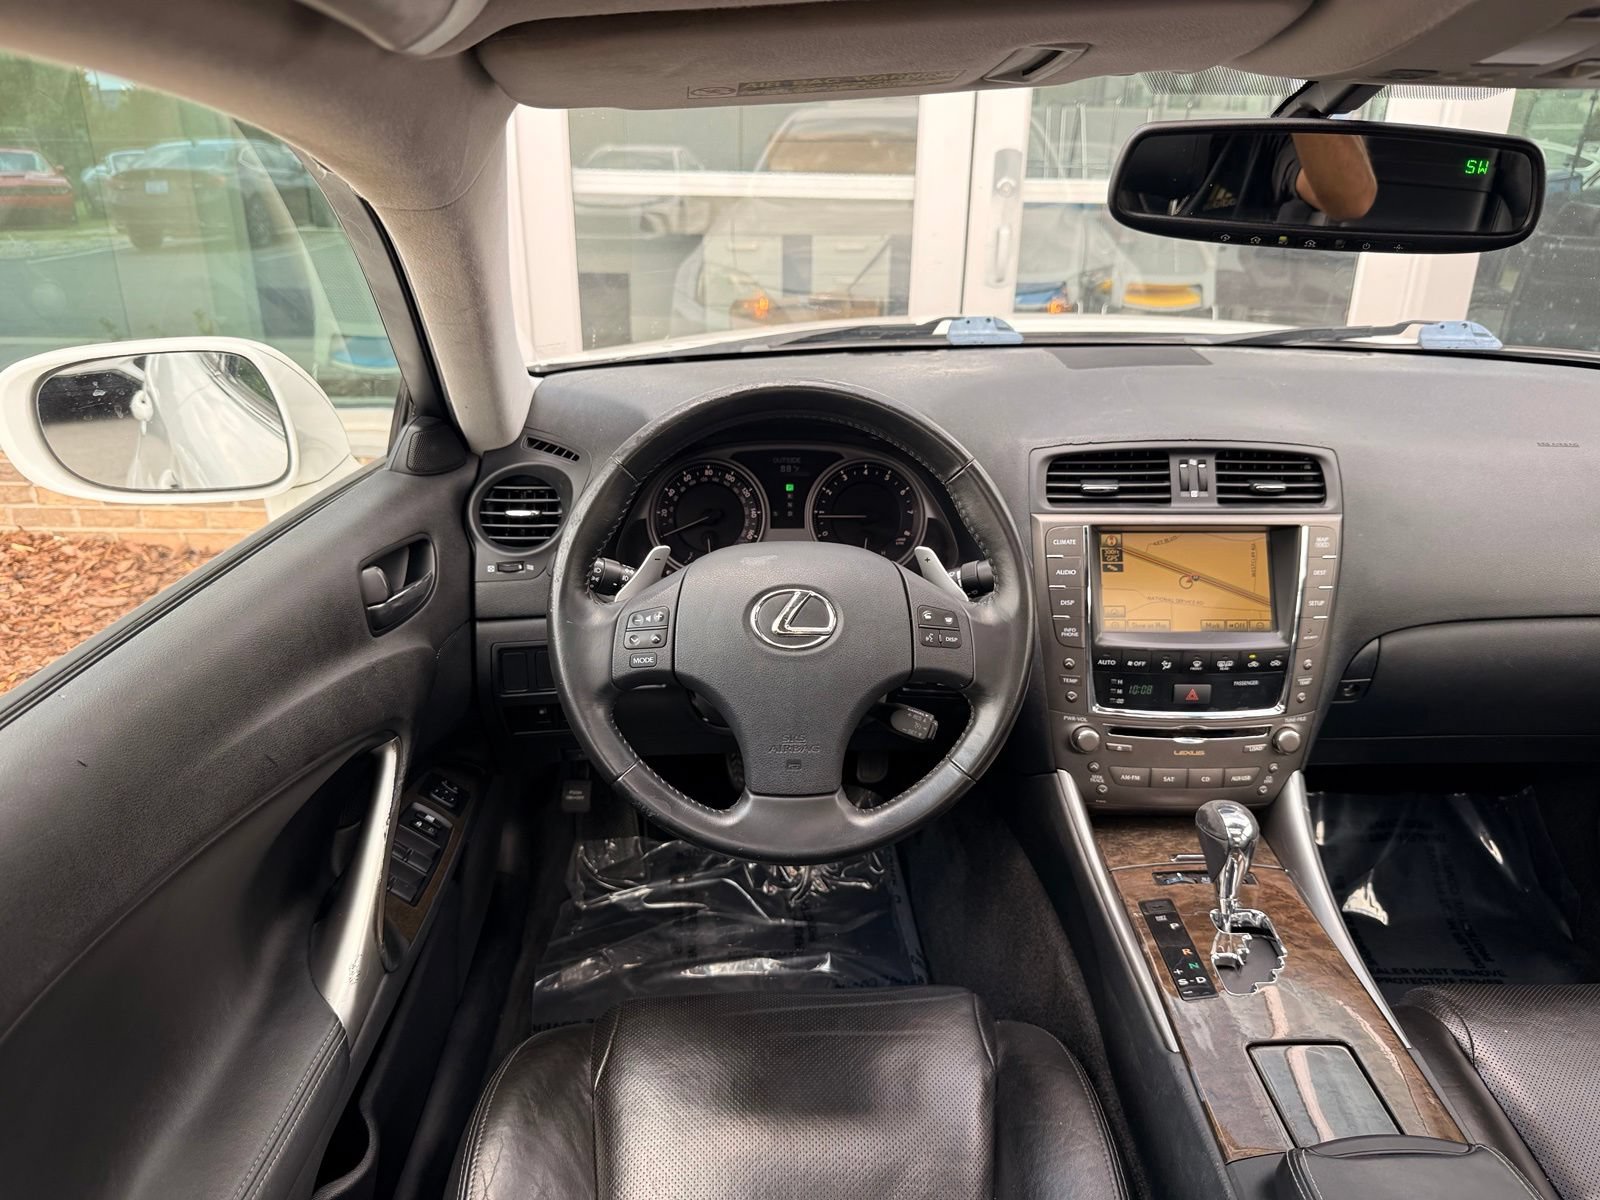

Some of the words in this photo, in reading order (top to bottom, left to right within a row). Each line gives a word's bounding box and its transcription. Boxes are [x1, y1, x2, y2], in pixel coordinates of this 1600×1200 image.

[1465, 159, 1489, 174] SW
[1128, 684, 1153, 695] 10:08
[768, 744, 821, 754] AIRBAG
[1169, 922, 1179, 930] P
